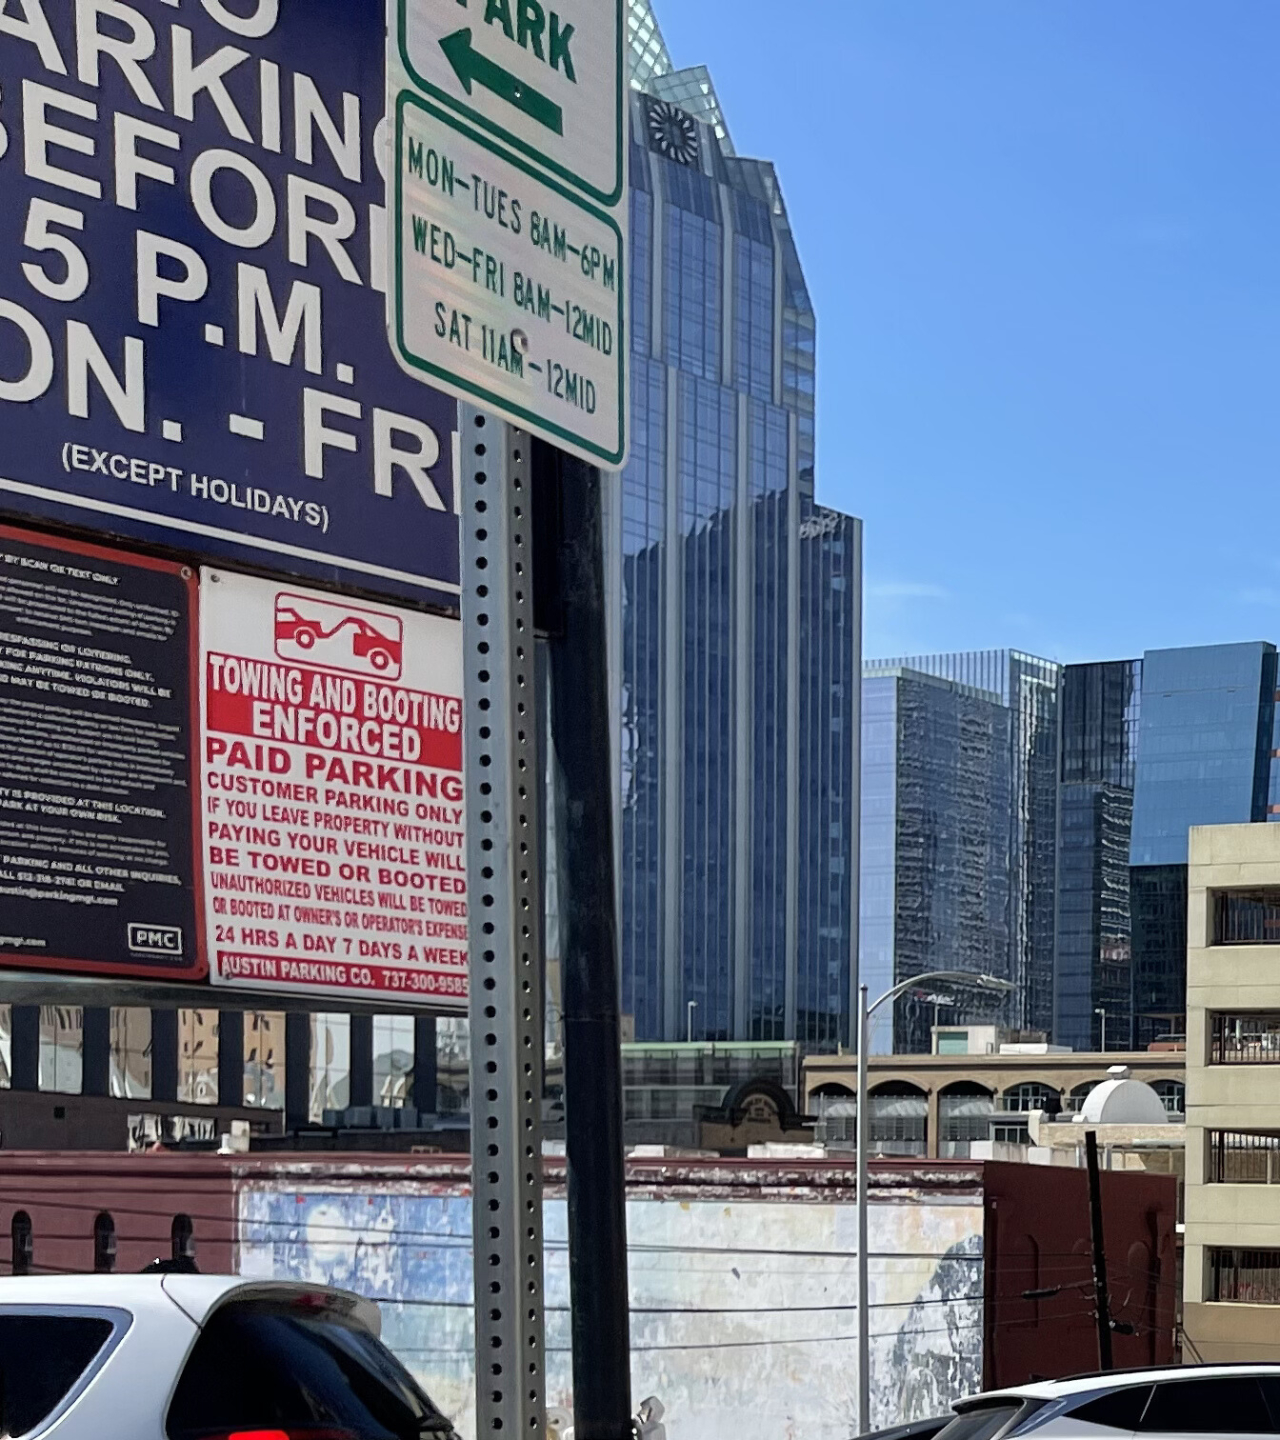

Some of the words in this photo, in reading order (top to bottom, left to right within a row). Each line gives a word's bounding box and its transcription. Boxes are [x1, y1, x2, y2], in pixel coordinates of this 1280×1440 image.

[457, 0, 577, 84] ARK
[0, 0, 387, 183] ARKIN
[0, 78, 386, 292] EFOR
[408, 136, 522, 234] MON-TUES
[530, 210, 616, 292] 8AM-6PM
[21, 197, 89, 302] 5
[137, 230, 355, 384] P.M.
[412, 214, 505, 297] WED-FRI
[513, 271, 613, 356] 8AM-12MID
[434, 301, 473, 351] SAT
[62, 442, 183, 492] (EXCEPT
[190, 473, 329, 534] HOLIDAYS)
[209, 655, 303, 705] TOWING
[309, 673, 356, 714] AND
[363, 683, 460, 733] BOOTING
[252, 700, 421, 762] ENFORCED
[206, 736, 291, 774] PAID
[305, 752, 463, 801] PARKING
[207, 771, 318, 804] CUSTOMER
[324, 789, 409, 817] PARKING
[415, 803, 463, 825] ONLY
[207, 796, 220, 814] IF
[225, 800, 257, 820] YOU
[262, 804, 309, 827] LEAVE
[314, 811, 390, 839] PROPERTY
[393, 823, 464, 849] WITHOUT
[208, 821, 281, 847] PAYING
[287, 832, 339, 856] YOUR
[343, 839, 420, 866] VEHICLE
[425, 850, 466, 872] WILL
[209, 845, 240, 867] BE
[247, 851, 331, 878] TOWED
[338, 863, 371, 884] OR
[378, 869, 467, 895] BOOTED
[210, 871, 311, 900] UNAUTHORIZED
[315, 884, 375, 908] VEHICLES
[377, 892, 407, 912] WILL
[410, 895, 426, 913] BE
[428, 898, 467, 918] TOWED
[212, 896, 228, 915] OR
[230, 898, 275, 920] BOOTED
[278, 904, 291, 921] AT
[293, 905, 342, 927] OWNER'S
[344, 912, 359, 928] OR
[361, 914, 424, 938] OPERATOR'S
[425, 920, 468, 941] EXPENSE
[136, 930, 176, 948] PMC
[215, 924, 235, 944] 24
[241, 927, 279, 948] HRS
[285, 932, 298, 950] A
[303, 934, 338, 954] DAY
[342, 938, 353, 955] 7
[358, 940, 402, 960] DAYS
[407, 945, 419, 962] A
[221, 955, 277, 978] AUSTIN
[281, 960, 347, 985] PARKING
[350, 967, 375, 986] CO.
